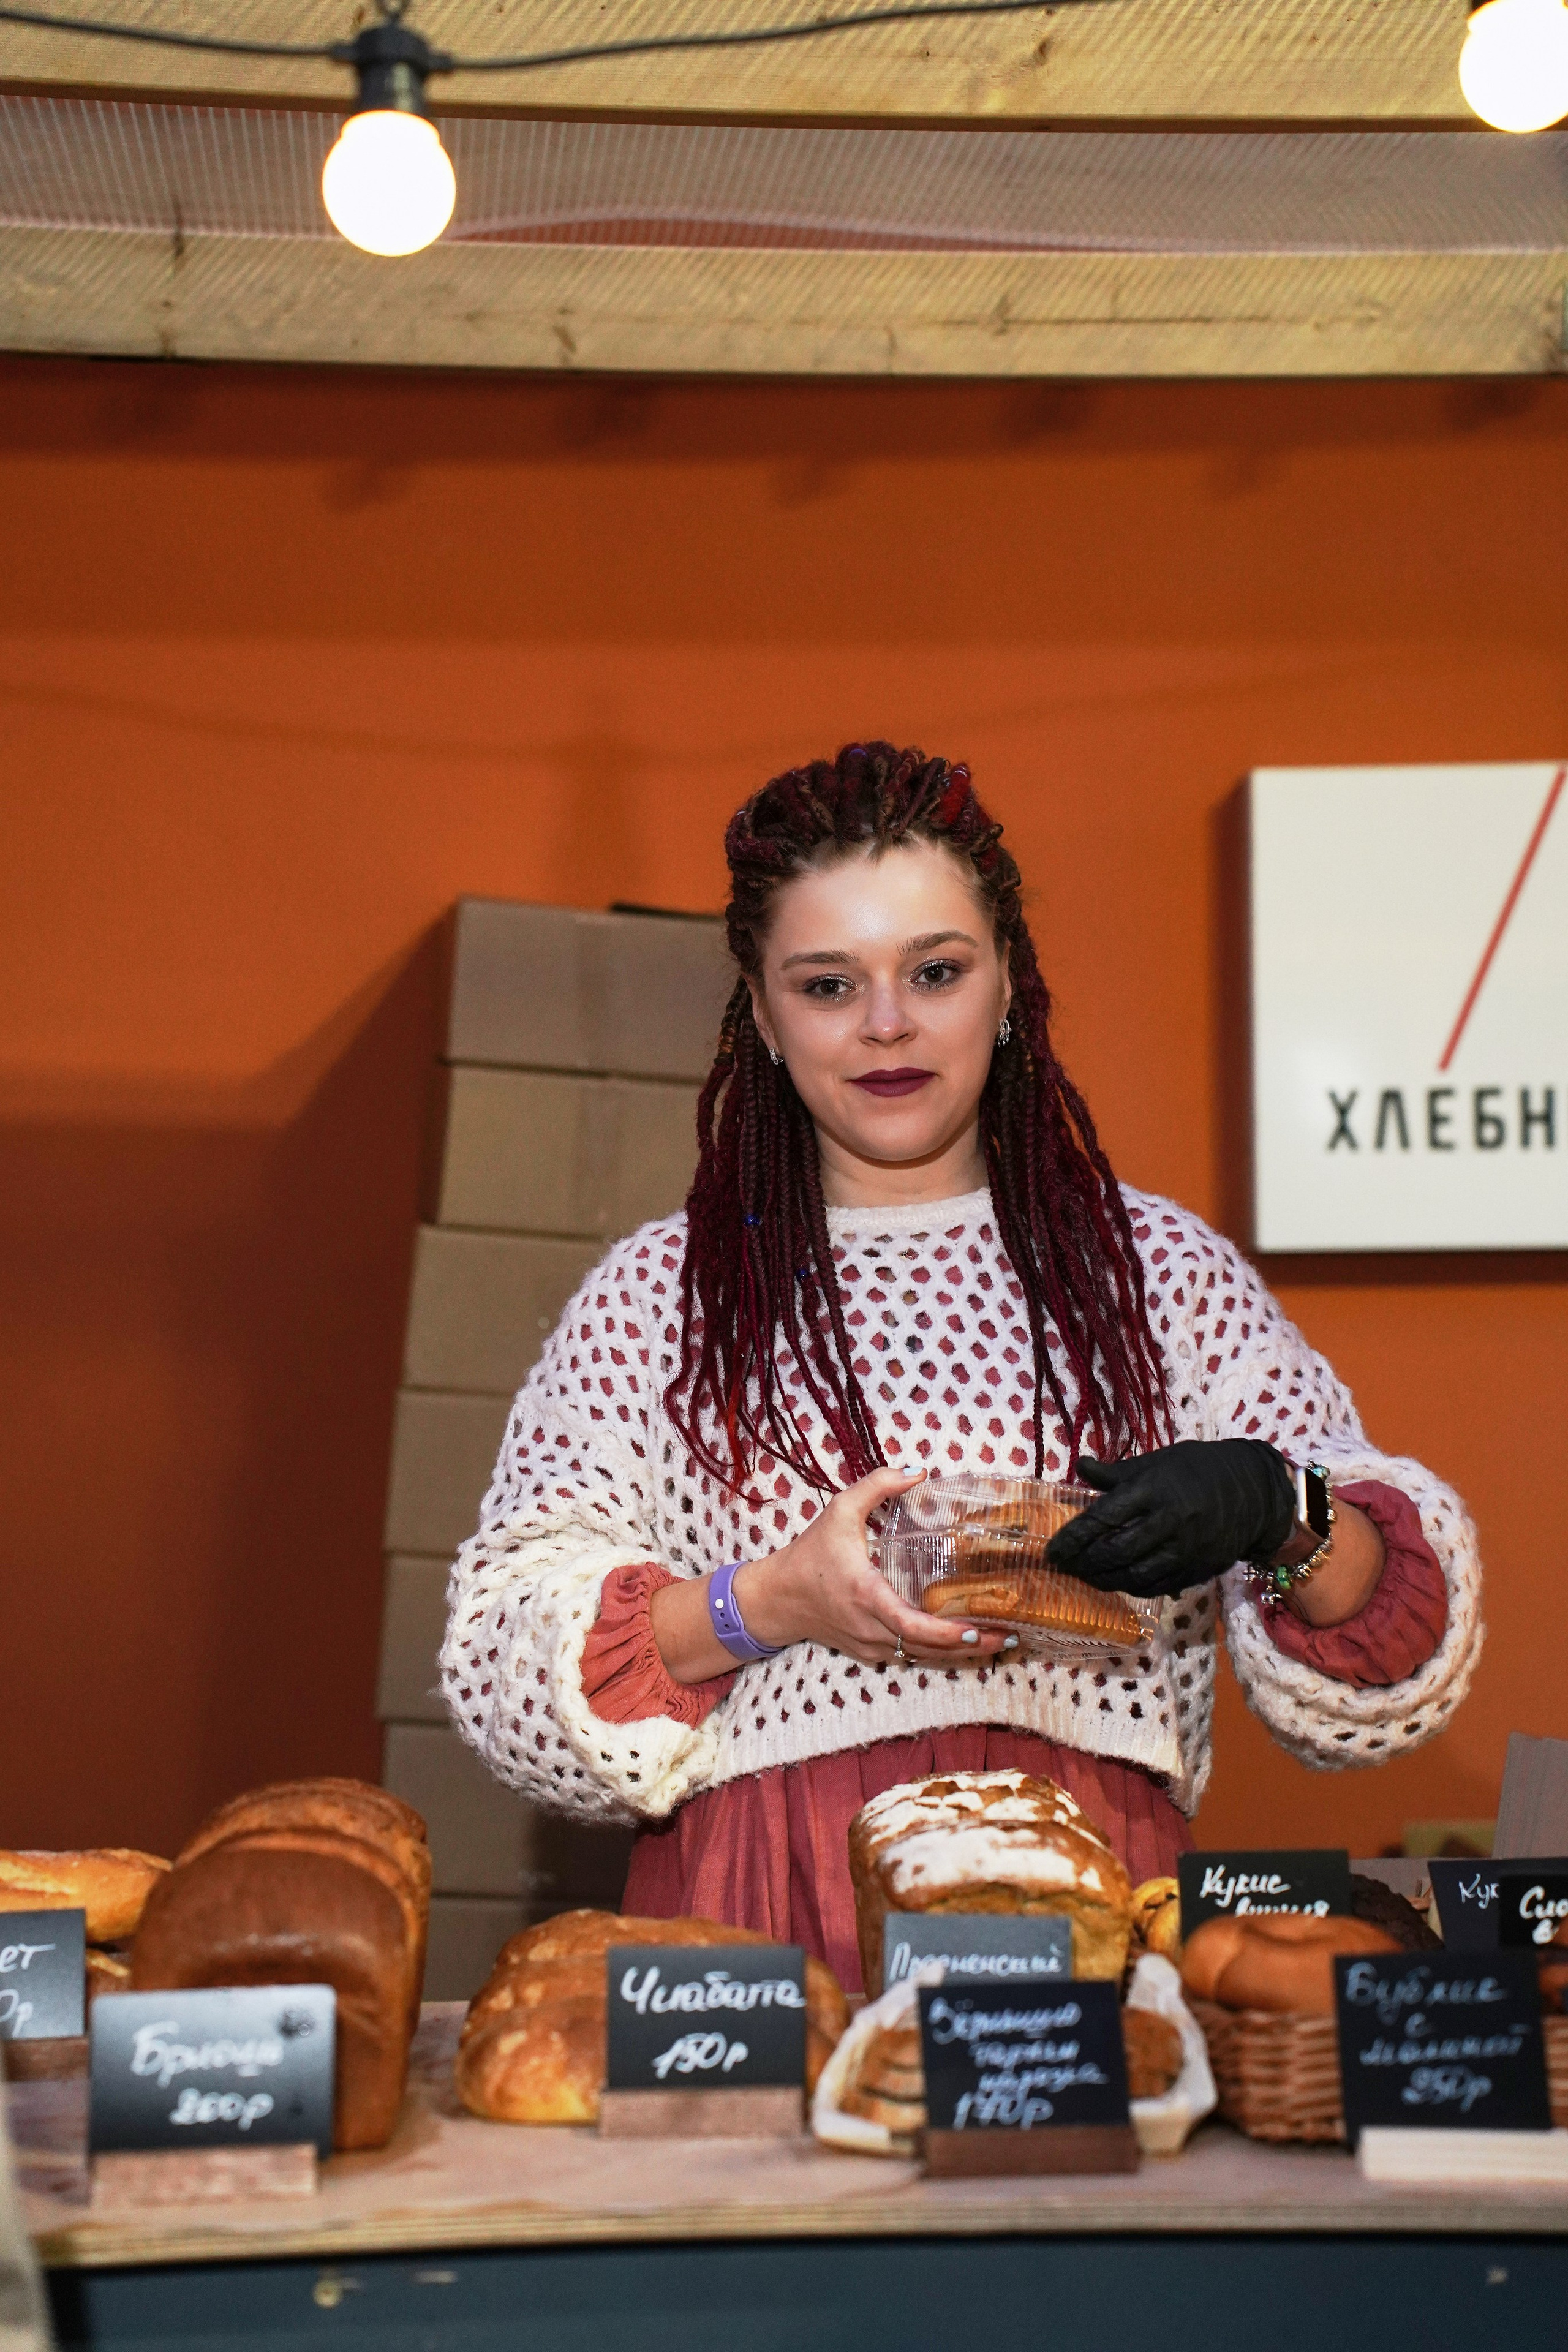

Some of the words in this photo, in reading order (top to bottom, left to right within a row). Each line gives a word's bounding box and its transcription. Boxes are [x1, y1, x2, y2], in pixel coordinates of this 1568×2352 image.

[1326, 1084, 1556, 1152] ХЛЕБН
[620, 1965, 807, 2015] Чиабата
[652, 2032, 749, 2079] 150р
